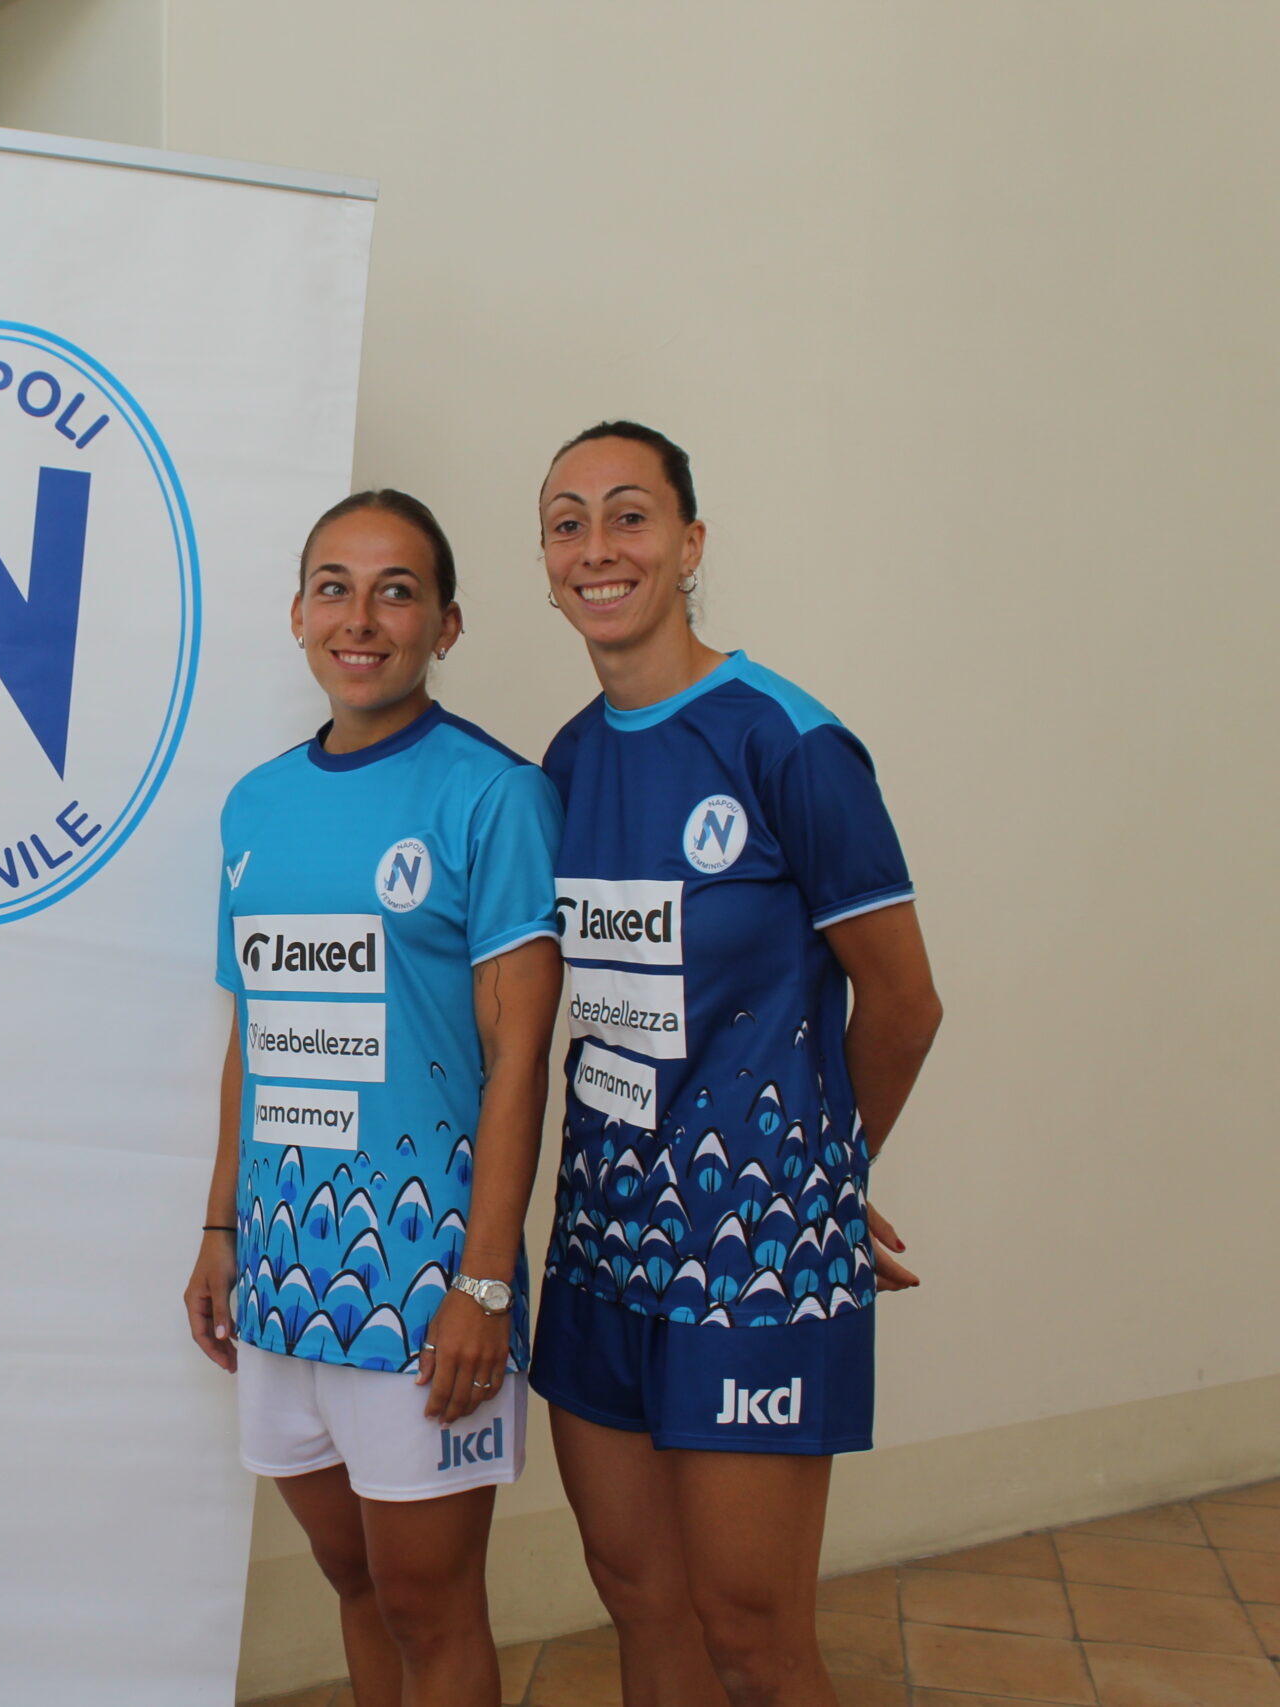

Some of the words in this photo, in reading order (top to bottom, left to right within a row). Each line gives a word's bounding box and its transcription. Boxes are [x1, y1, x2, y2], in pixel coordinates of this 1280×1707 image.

[708, 800, 740, 814] NAPOLI
[397, 842, 425, 855] NAPOLI
[580, 900, 672, 943] Jaked
[271, 932, 376, 973] Jaked
[569, 993, 679, 1032] deabellezza
[257, 1025, 380, 1056] ideabellezza
[577, 1060, 652, 1110] yamamay
[255, 1104, 355, 1133] yamamay
[716, 1377, 802, 1425] Jkd
[437, 1417, 503, 1472] Jkd
